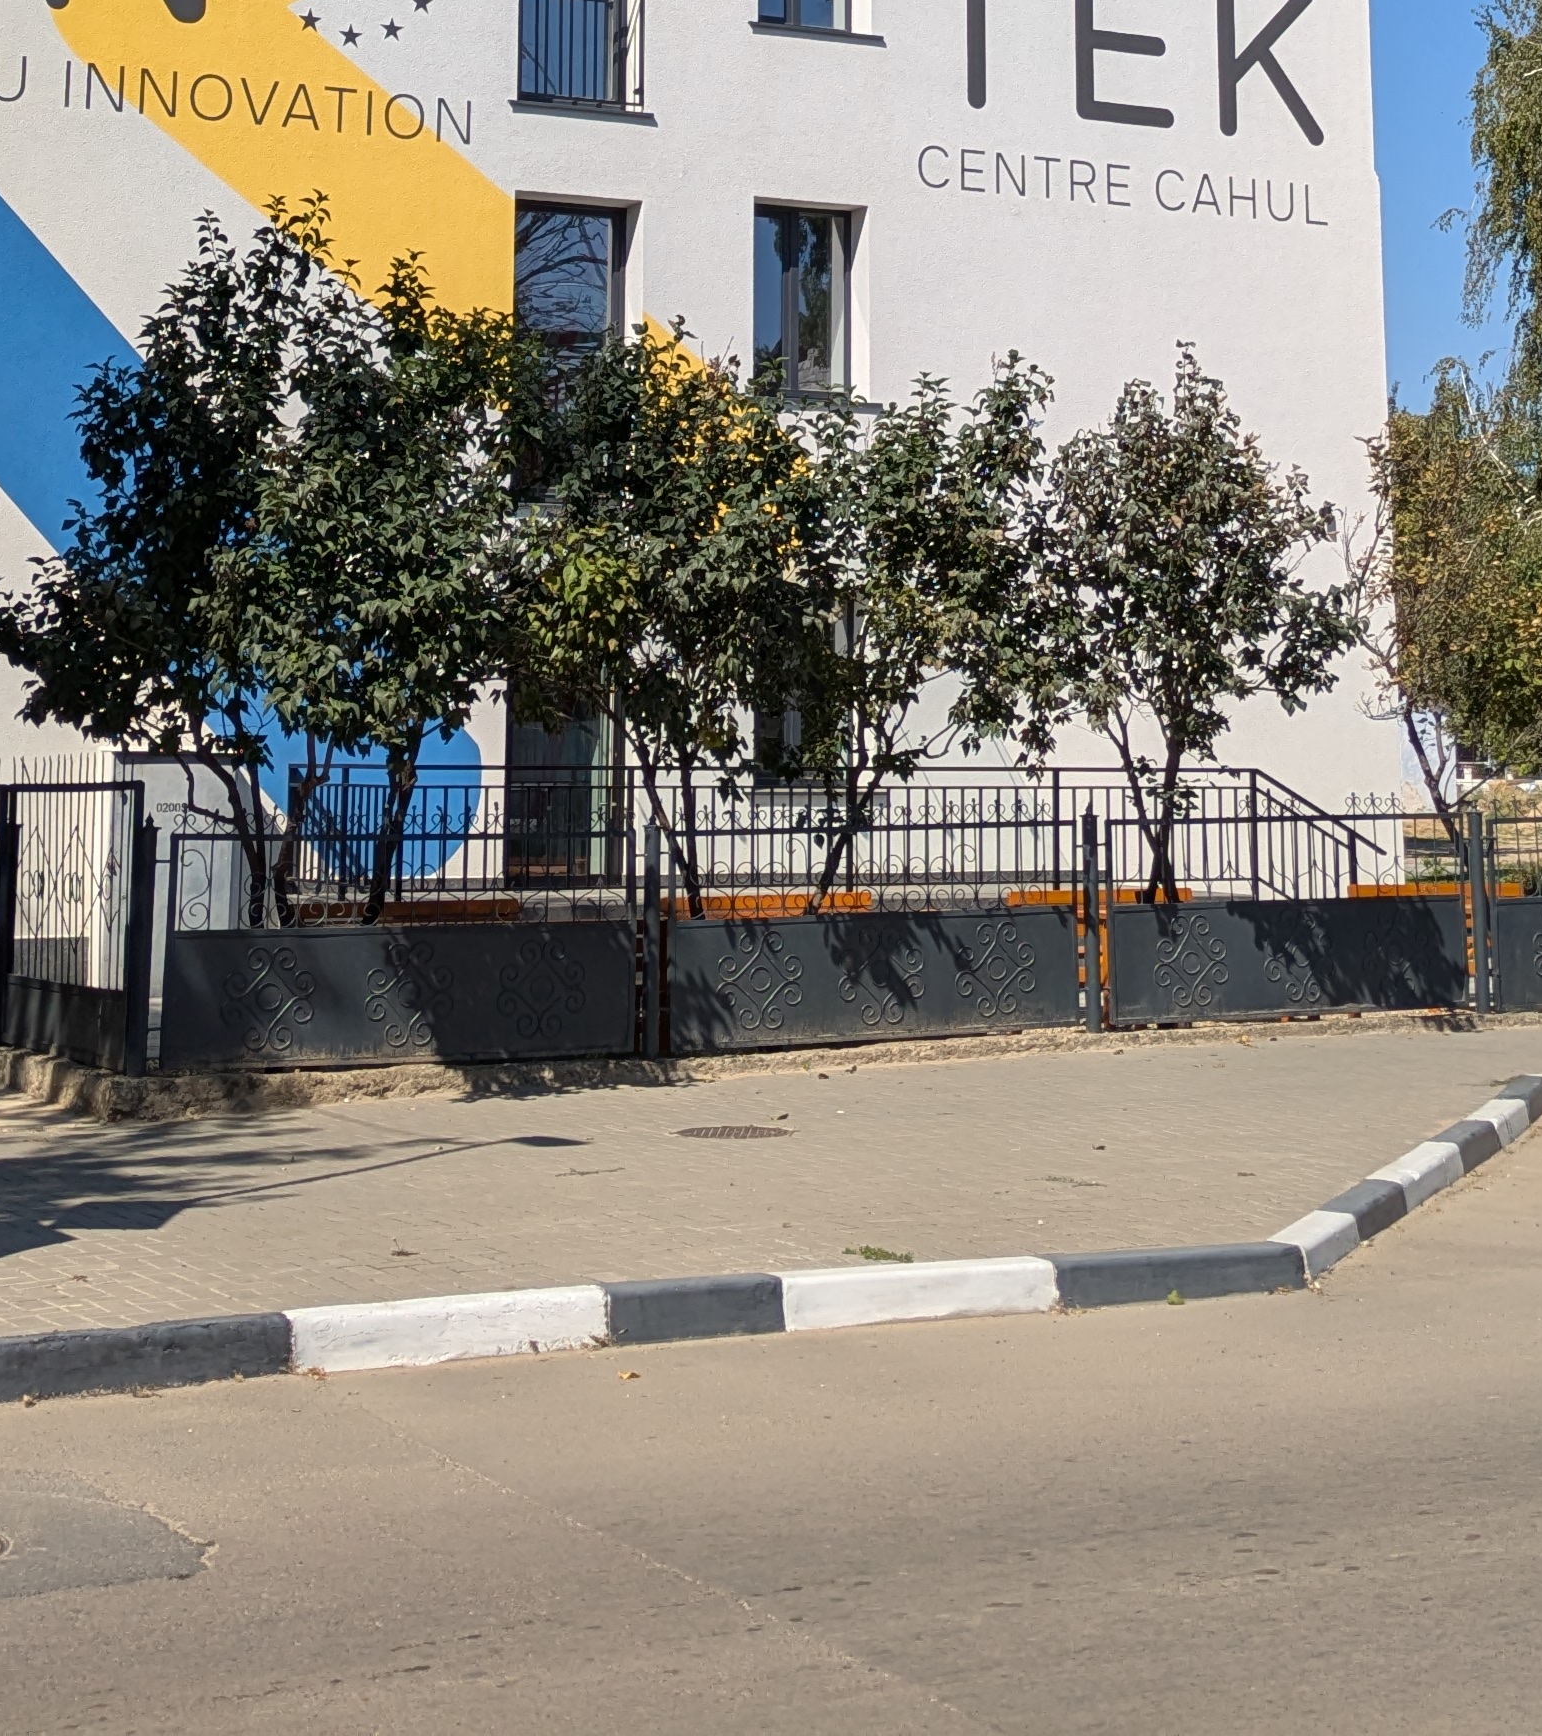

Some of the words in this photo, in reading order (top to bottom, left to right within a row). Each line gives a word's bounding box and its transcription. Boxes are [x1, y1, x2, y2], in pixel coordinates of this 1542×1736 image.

[63, 60, 473, 145] INNOVATION
[917, 145, 1132, 207] CENTRE
[1155, 169, 1329, 226] CAHUL
